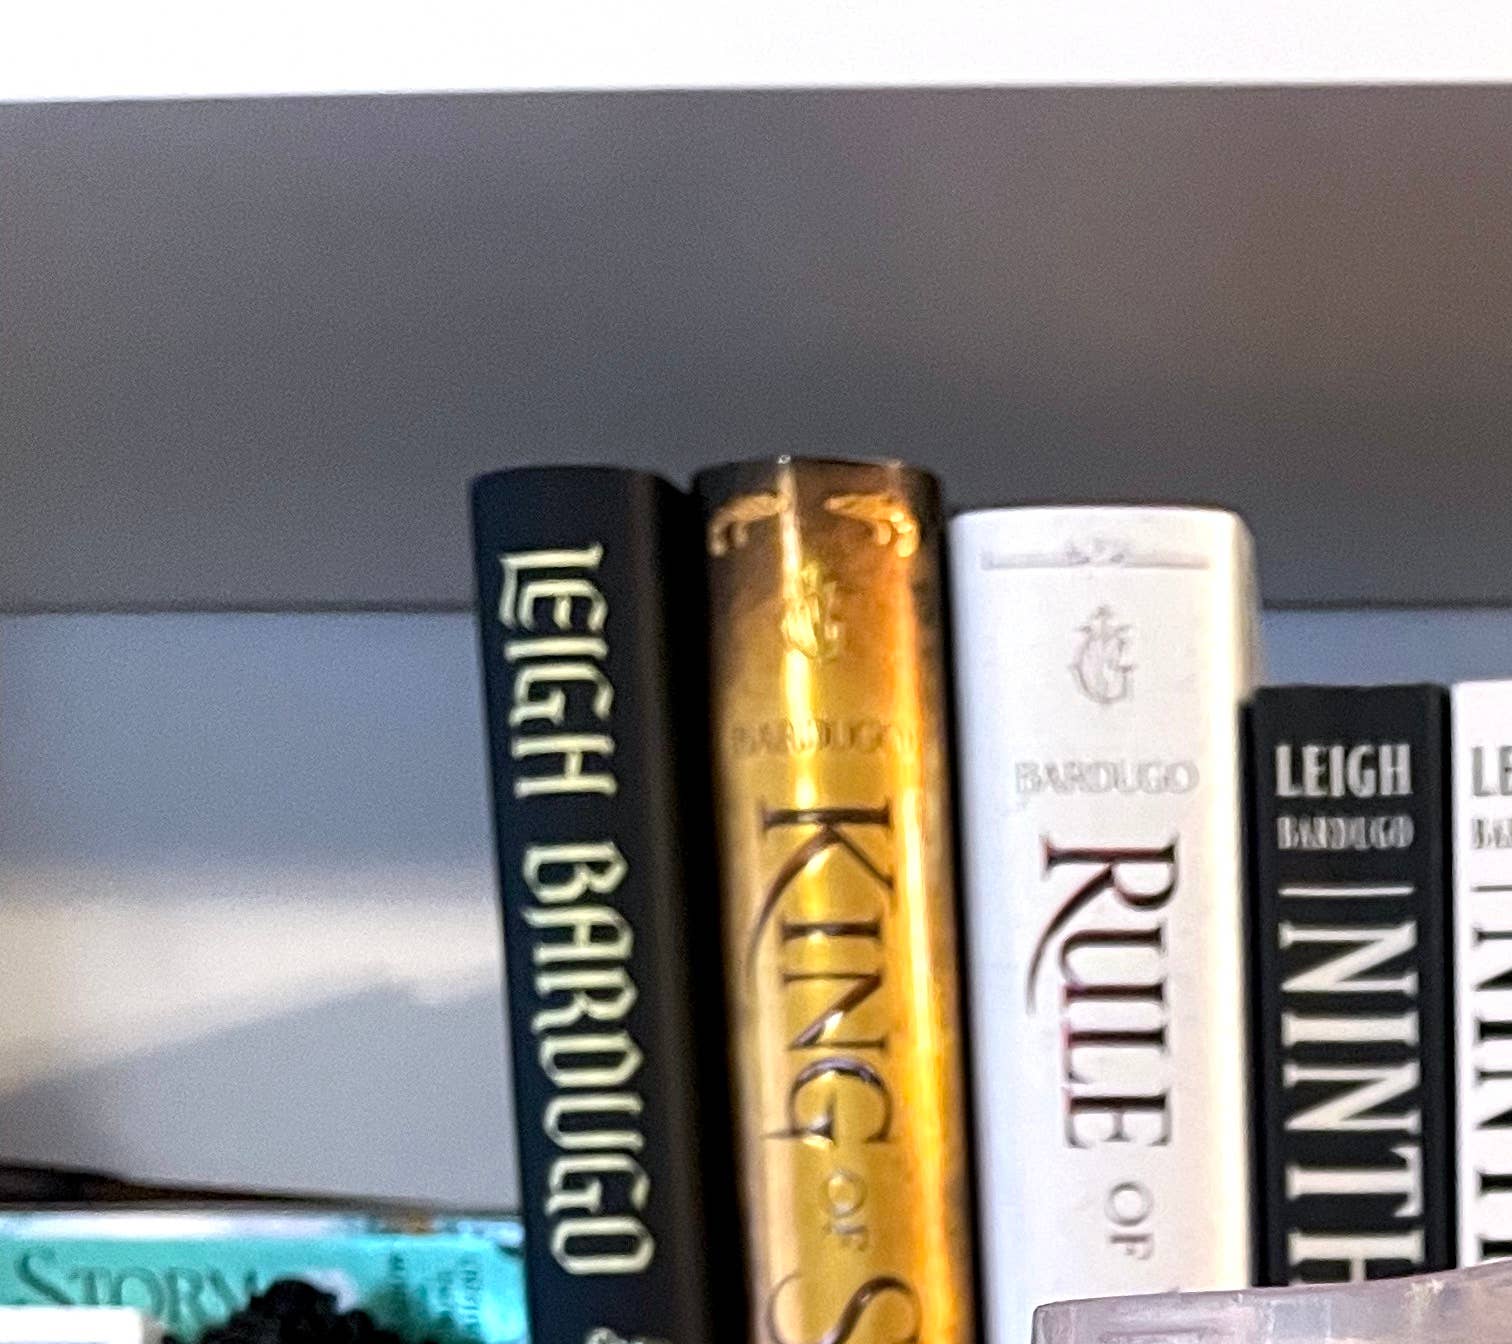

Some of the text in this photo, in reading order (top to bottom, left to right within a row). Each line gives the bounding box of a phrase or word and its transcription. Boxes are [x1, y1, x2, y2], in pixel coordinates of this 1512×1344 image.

[1014, 760, 1200, 795] BARDUGO
[1275, 743, 1412, 798] LEIGH
[1277, 813, 1414, 850] BARDUGO
[498, 544, 655, 1276] LEIGH BARDUGO
[745, 797, 897, 1147] KING
[1026, 832, 1182, 1262] RULE OF
